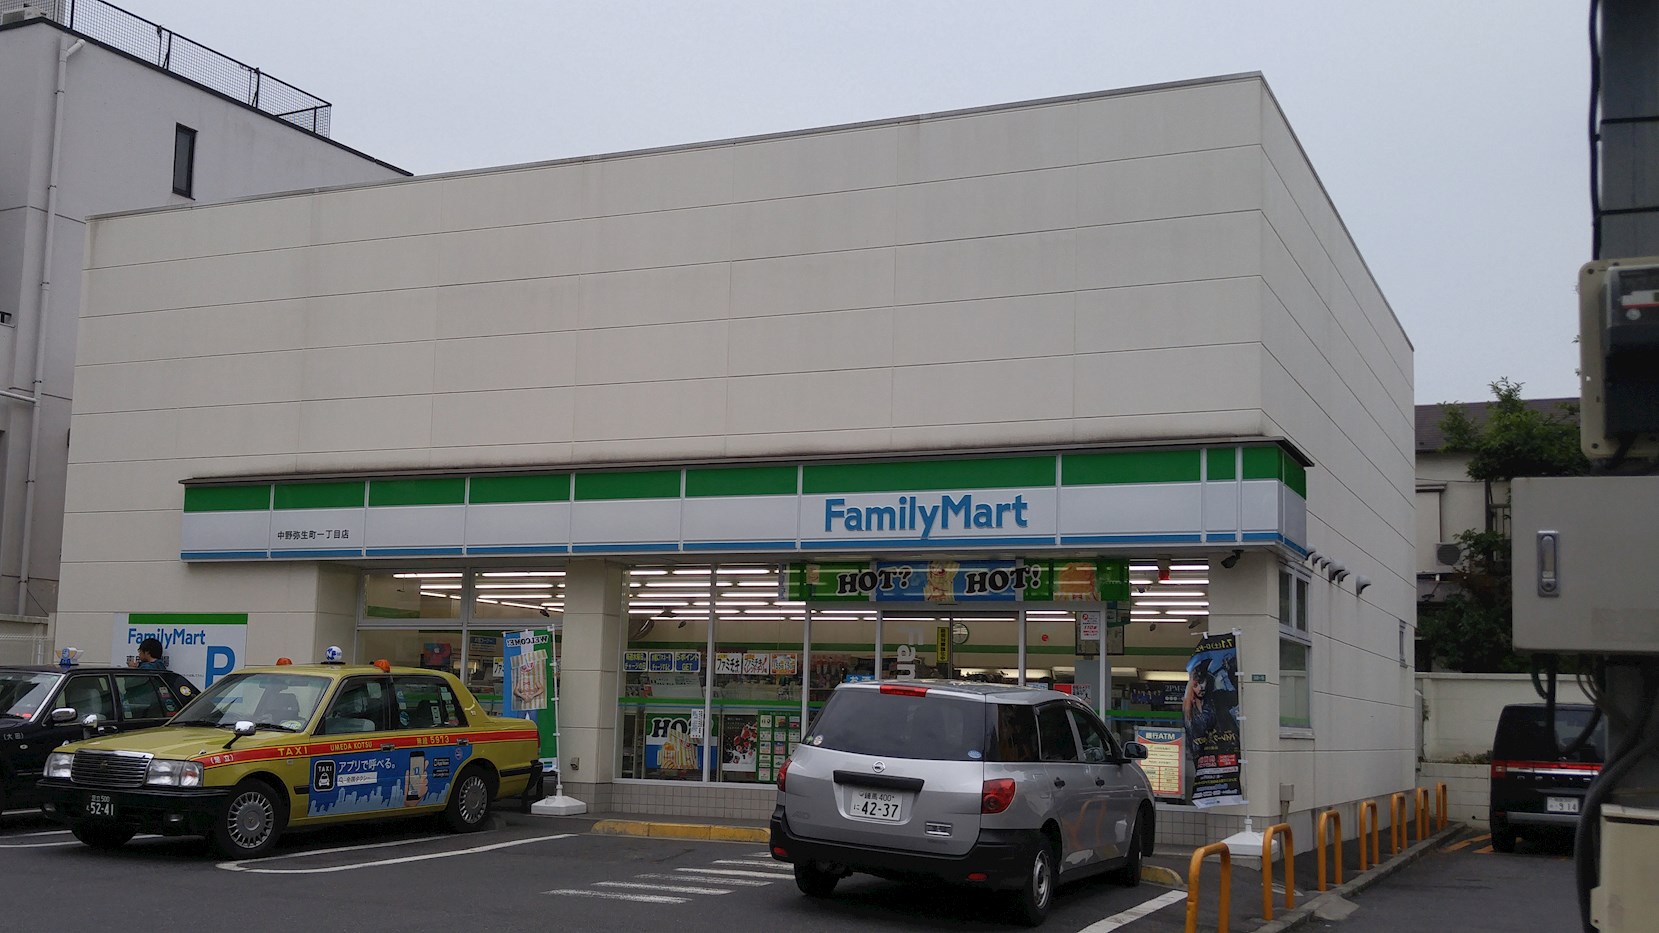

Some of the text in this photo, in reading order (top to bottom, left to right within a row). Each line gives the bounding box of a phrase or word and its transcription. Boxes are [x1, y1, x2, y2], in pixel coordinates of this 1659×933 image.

[825, 494, 1028, 540] FamilyMart
[277, 529, 350, 540] 中野弥生町一丁目店
[838, 569, 912, 594] HOT?
[966, 566, 1041, 594] HOT!
[205, 645, 236, 689] P
[330, 741, 373, 752] UMEDA KOTSU
[430, 735, 450, 744] 5973
[278, 746, 308, 757] TAXI
[338, 758, 396, 773] アプリで呼べる。
[879, 794, 892, 802] 400
[90, 802, 114, 816] 52-41
[862, 801, 899, 818] 42-37
